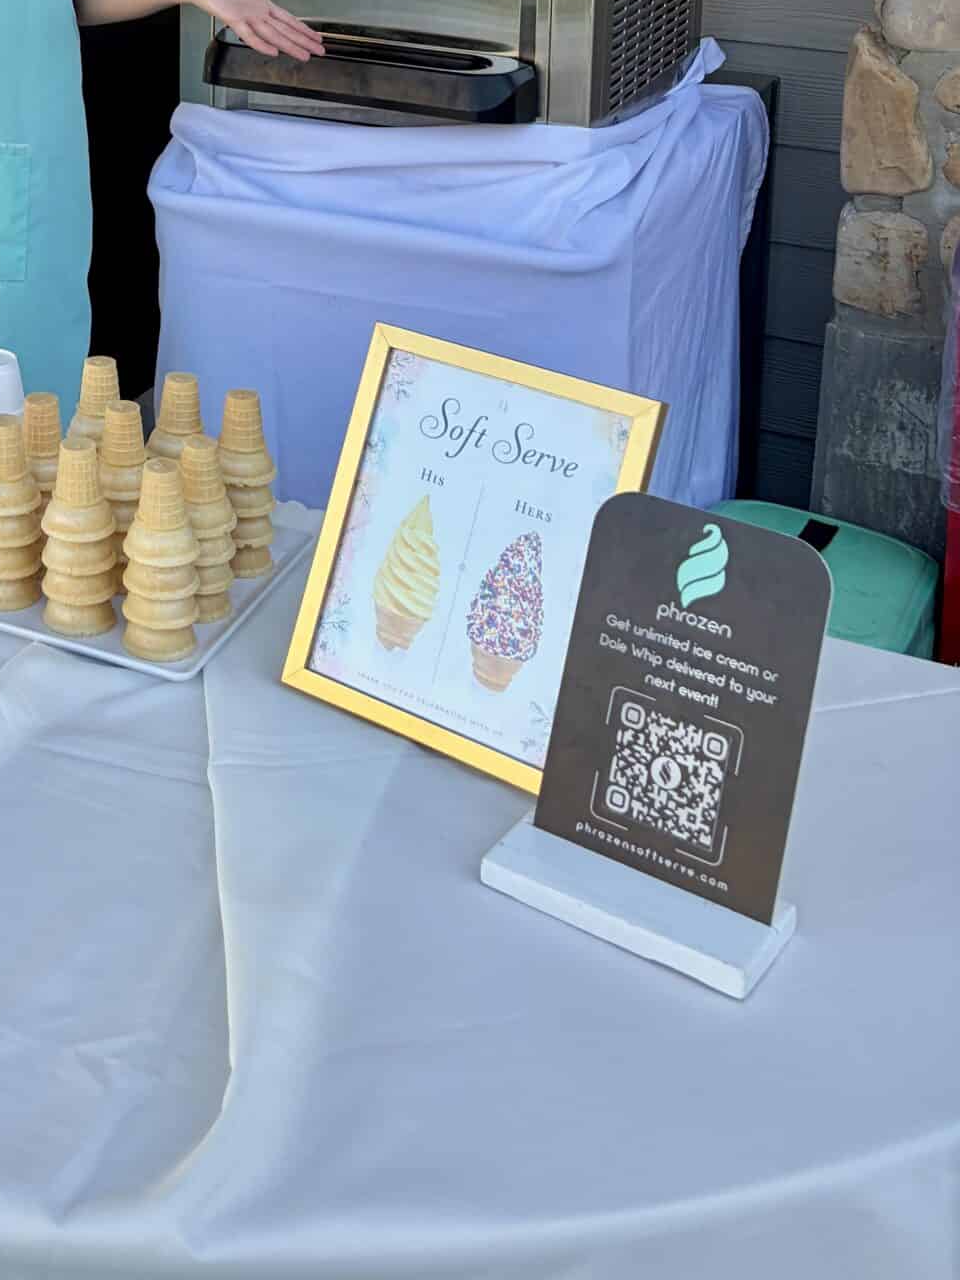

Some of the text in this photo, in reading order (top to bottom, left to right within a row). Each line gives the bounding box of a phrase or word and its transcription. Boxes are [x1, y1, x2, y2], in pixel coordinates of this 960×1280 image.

[420, 398, 579, 478] Soft Serve
[606, 613, 779, 683] Get unlimited ice cream or
[656, 601, 732, 639] phrozen
[599, 632, 778, 706] Dole Whip delivered to your
[644, 673, 720, 709] next event!
[575, 821, 729, 892] phrozensoftserve.com
